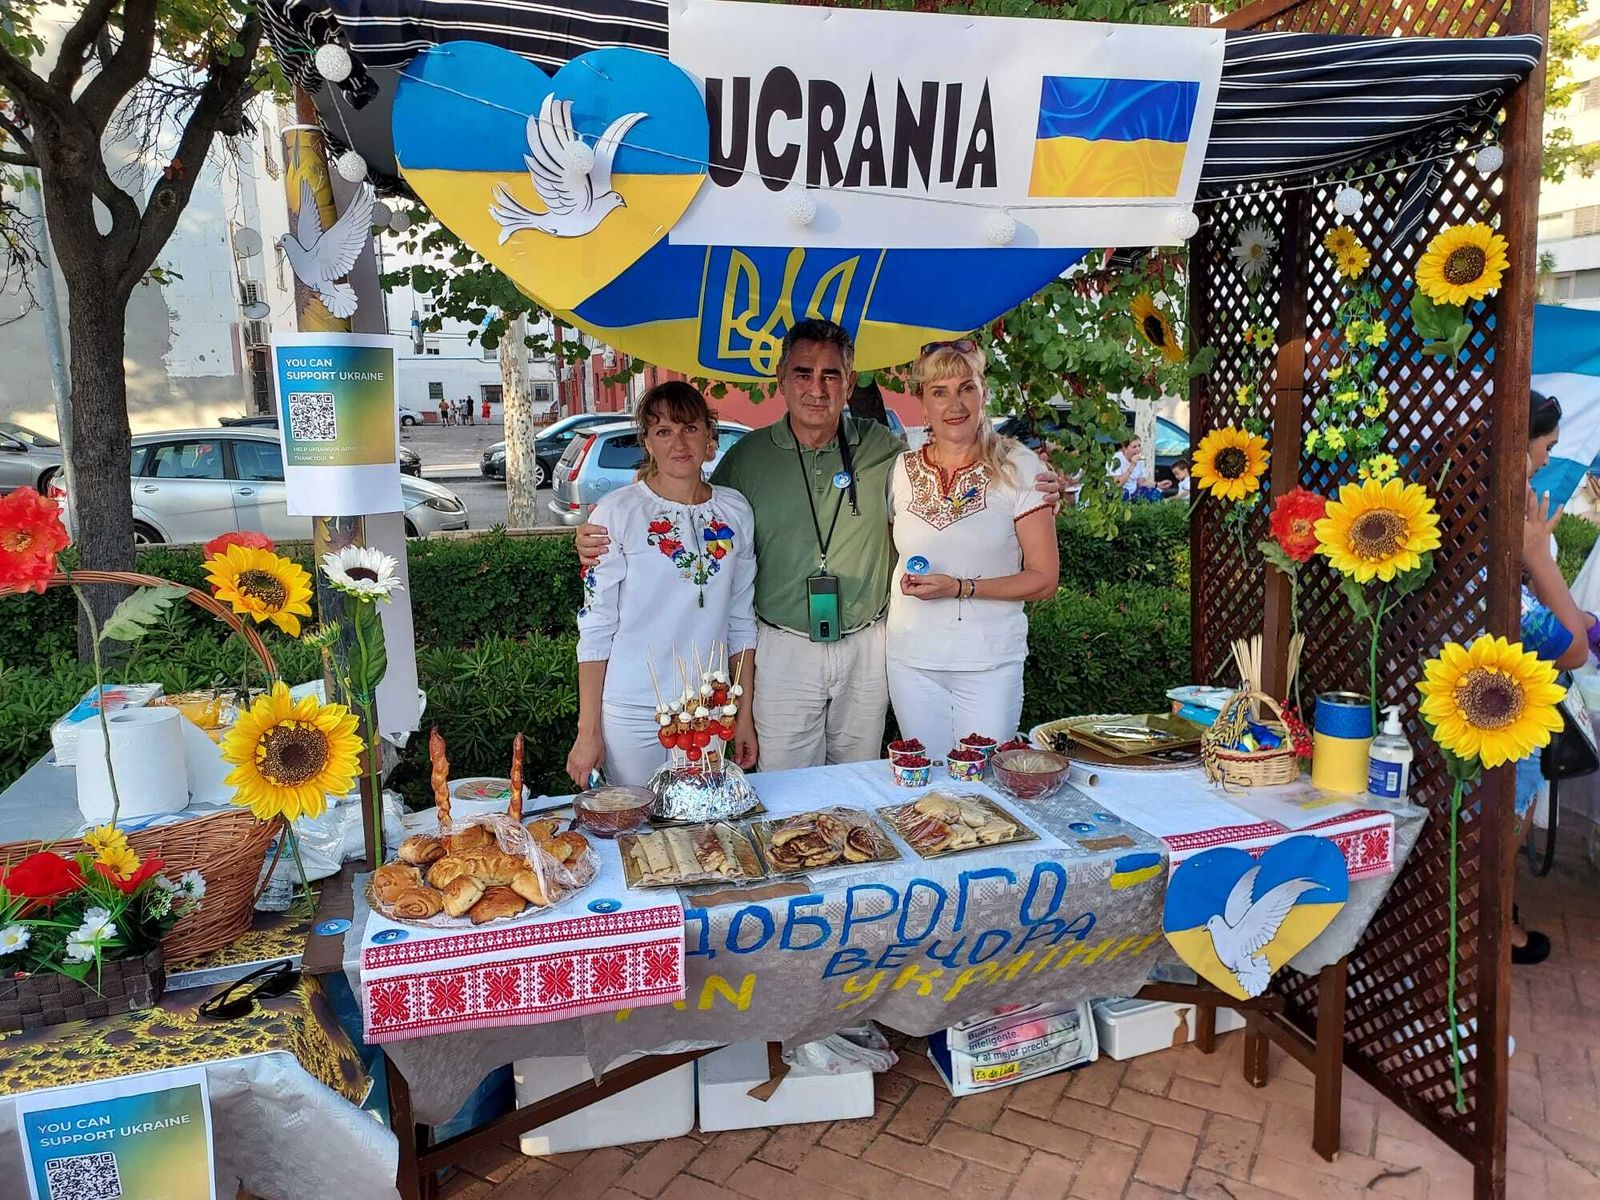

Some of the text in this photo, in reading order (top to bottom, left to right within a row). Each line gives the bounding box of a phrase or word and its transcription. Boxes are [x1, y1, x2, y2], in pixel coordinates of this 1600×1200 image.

[705, 66, 998, 193] UCRANIA
[285, 358, 333, 368] YOU CAN
[286, 371, 385, 381] SUPPORT UKRAINE
[685, 861, 1068, 960] ДОБРОГО
[822, 911, 1096, 979] ВЕЧОРА
[983, 1052, 992, 1061] al
[993, 1048, 1020, 1060] mejor
[37, 1114, 111, 1134] YOU CAN
[40, 1114, 191, 1147] SUPPORT UKRAINE
